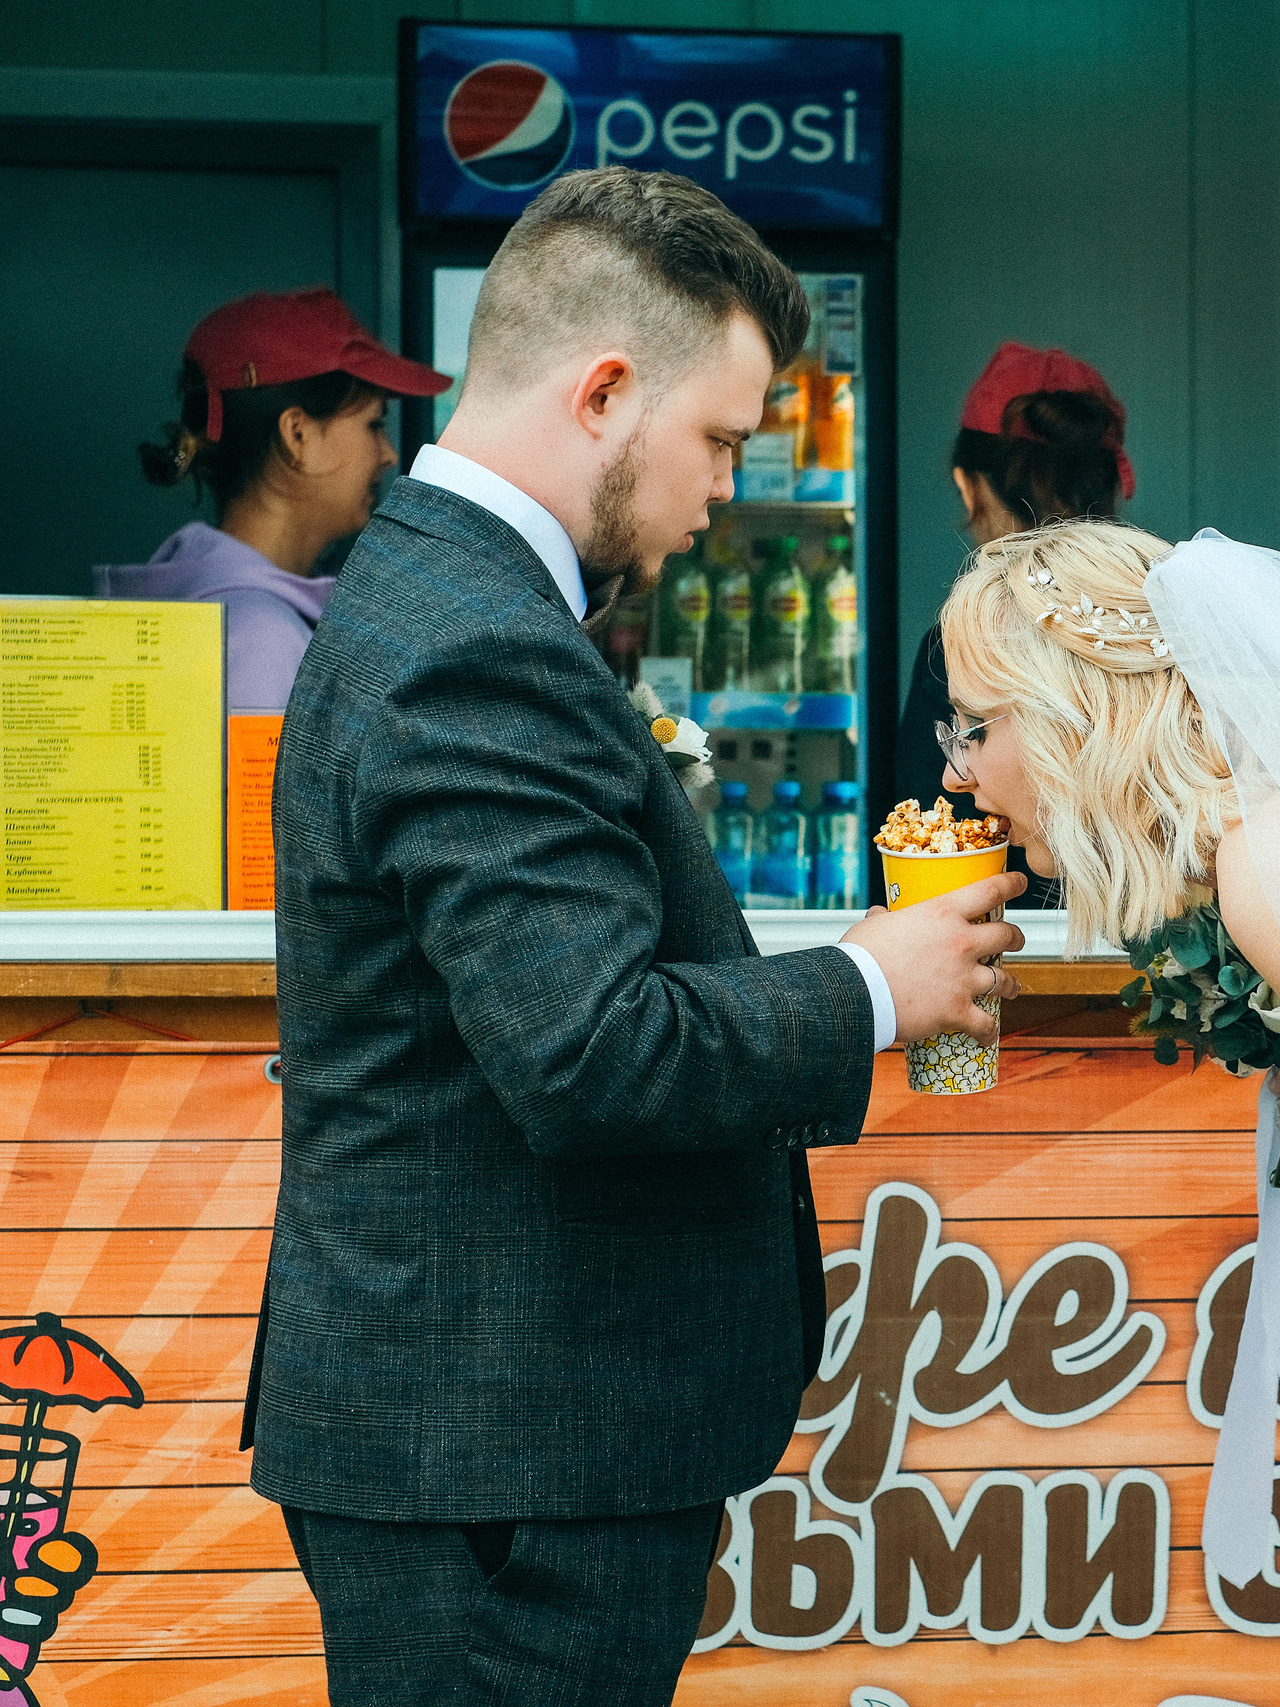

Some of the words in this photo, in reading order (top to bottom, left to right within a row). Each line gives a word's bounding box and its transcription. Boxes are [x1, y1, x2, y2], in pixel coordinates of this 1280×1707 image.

[596, 88, 859, 180] pepsi
[5, 807, 50, 815] Нежность
[5, 823, 56, 831] Шоколадка
[5, 838, 32, 846] Банан
[6, 854, 32, 863] Черри
[6, 868, 53, 877] Клубничка
[6, 887, 61, 896] Мандаринка
